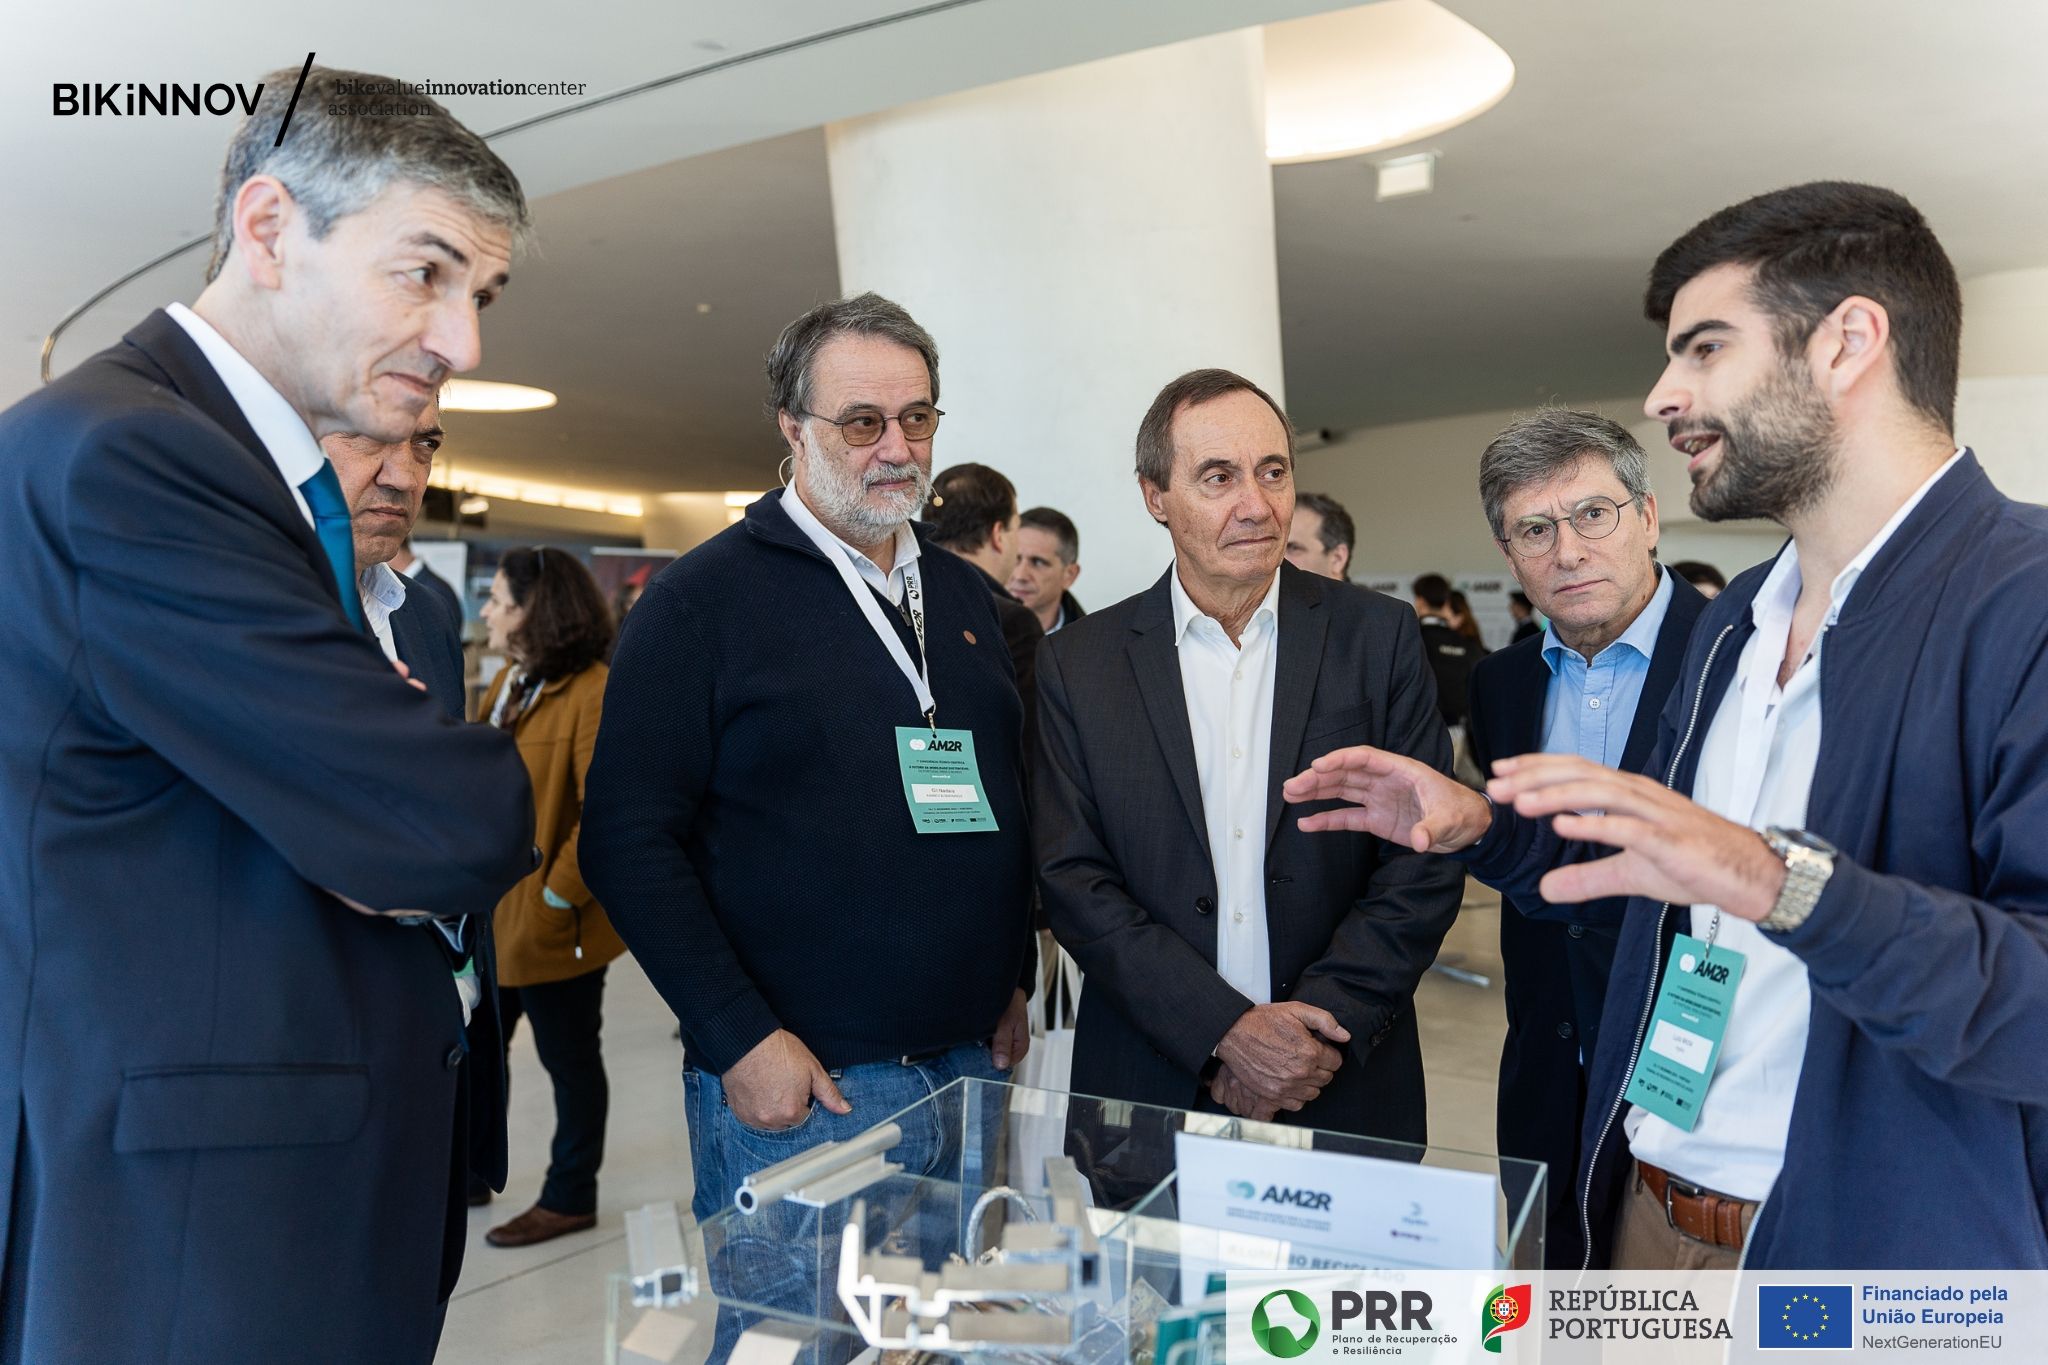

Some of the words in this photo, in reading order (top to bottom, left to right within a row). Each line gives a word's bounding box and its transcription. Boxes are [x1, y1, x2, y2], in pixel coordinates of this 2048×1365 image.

[906, 576, 914, 589] PRR
[928, 741, 962, 752] AM2R
[1694, 960, 1729, 985] AM2R
[1262, 1185, 1332, 1211] AM2R
